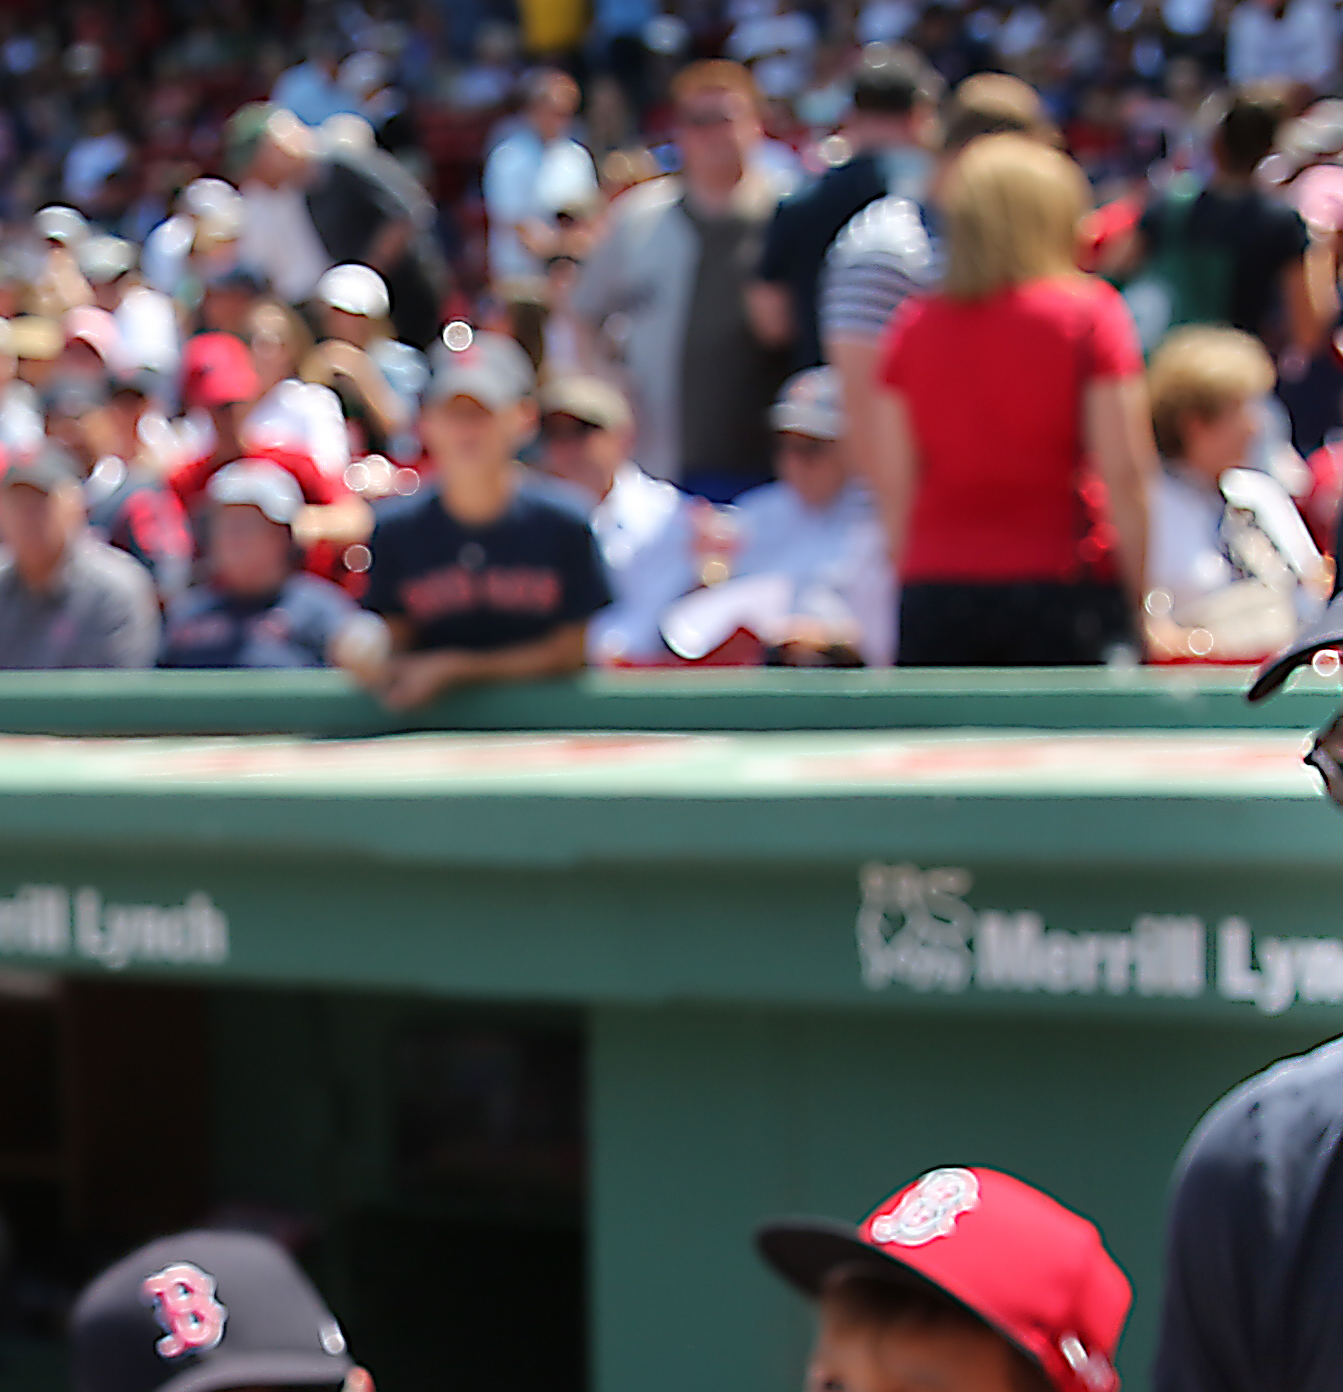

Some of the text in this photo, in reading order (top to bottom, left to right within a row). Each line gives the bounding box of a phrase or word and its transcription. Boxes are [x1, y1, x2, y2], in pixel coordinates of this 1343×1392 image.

[73, 885, 230, 970] Lynch
[972, 909, 1204, 998] Merrill
[870, 1168, 979, 1246] B
[141, 1262, 228, 1357] B
